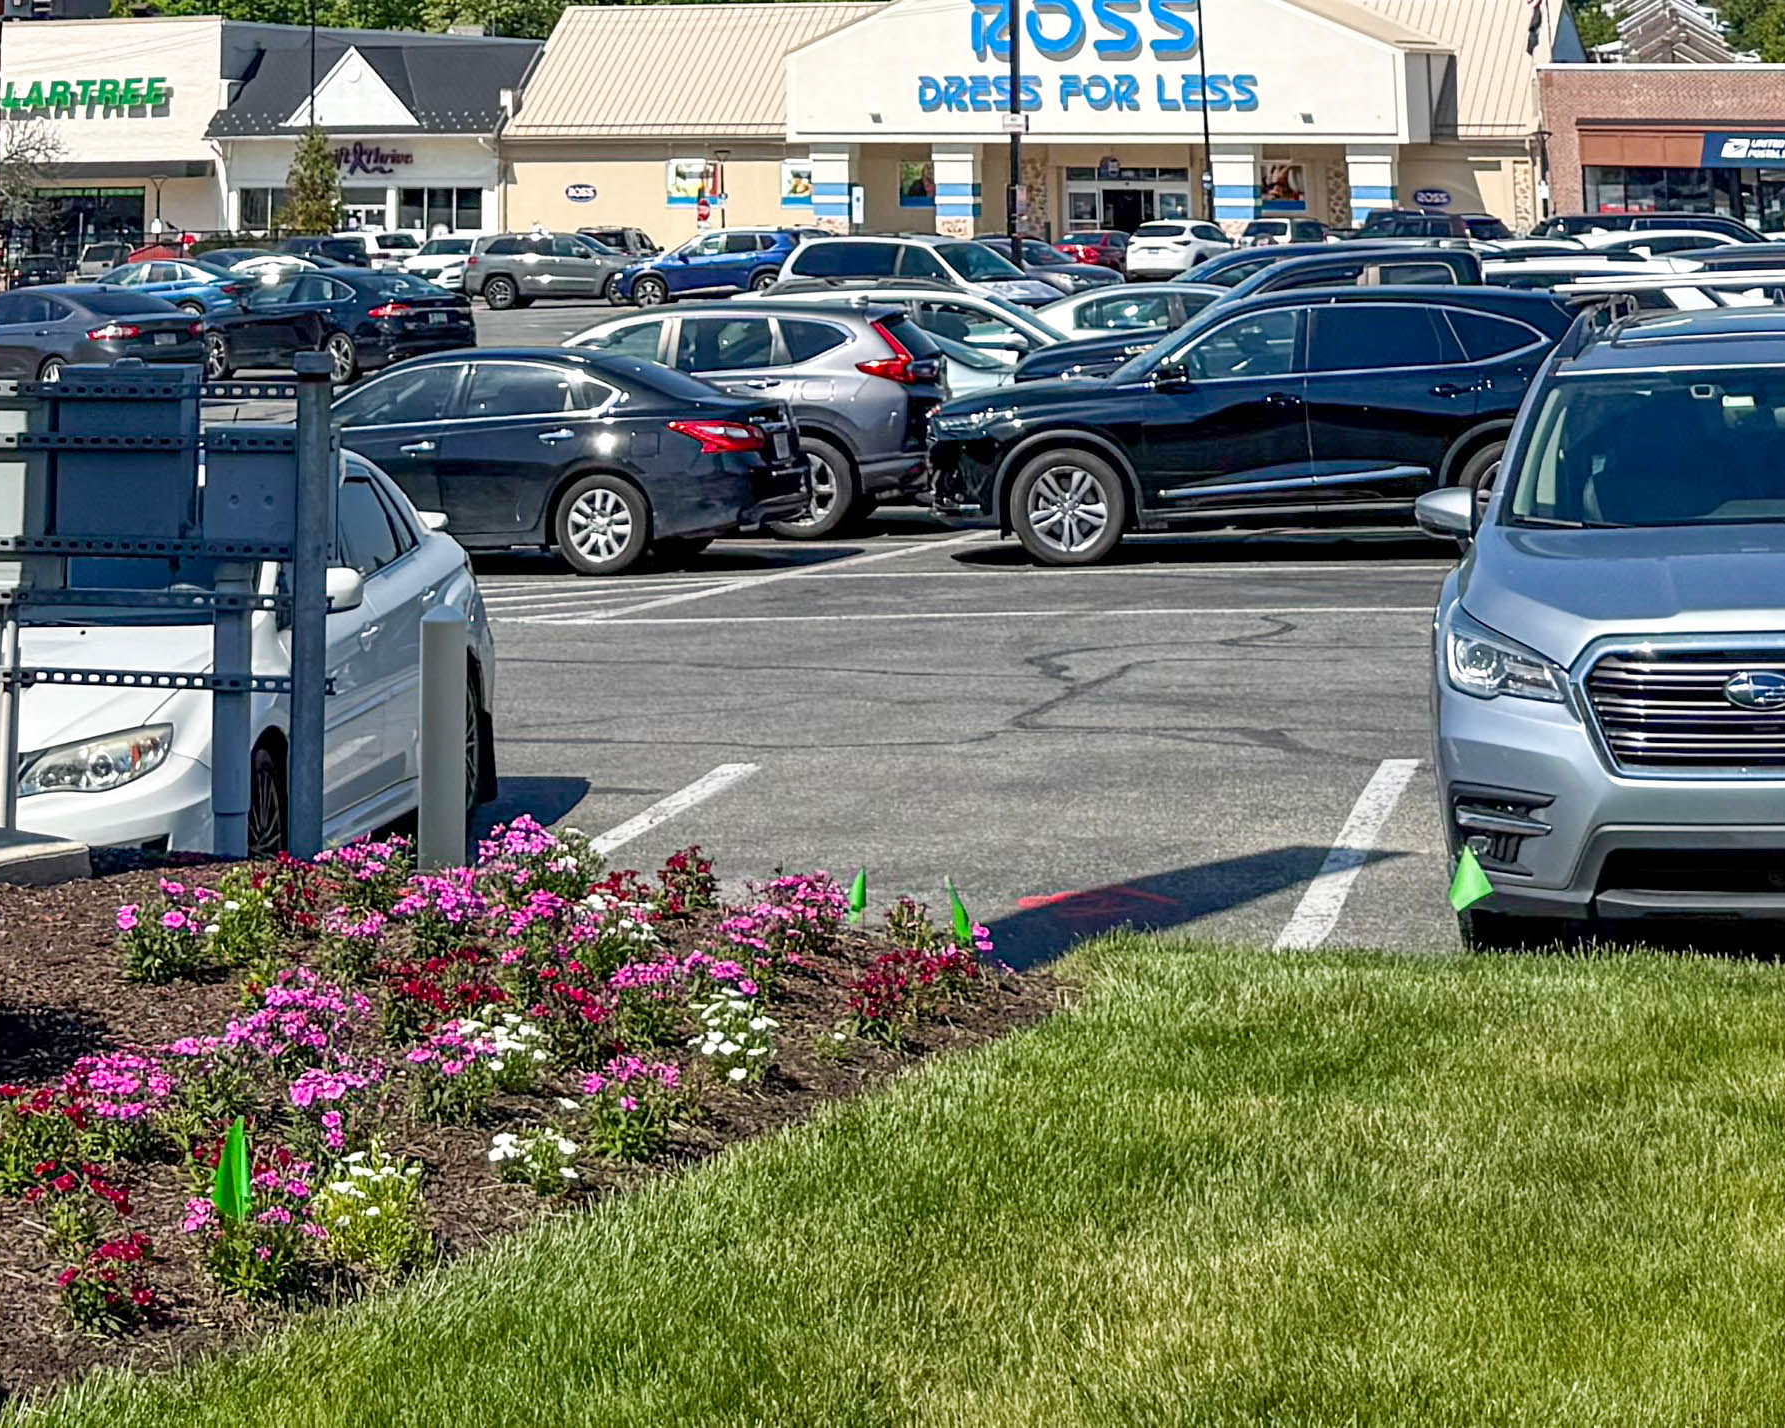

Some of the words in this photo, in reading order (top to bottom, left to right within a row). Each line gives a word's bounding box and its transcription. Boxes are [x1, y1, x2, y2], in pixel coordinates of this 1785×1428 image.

[76, 77, 167, 105] TREE
[919, 75, 1042, 111] DRESS
[1060, 74, 1140, 111] FOR
[1157, 74, 1259, 111] LESS
